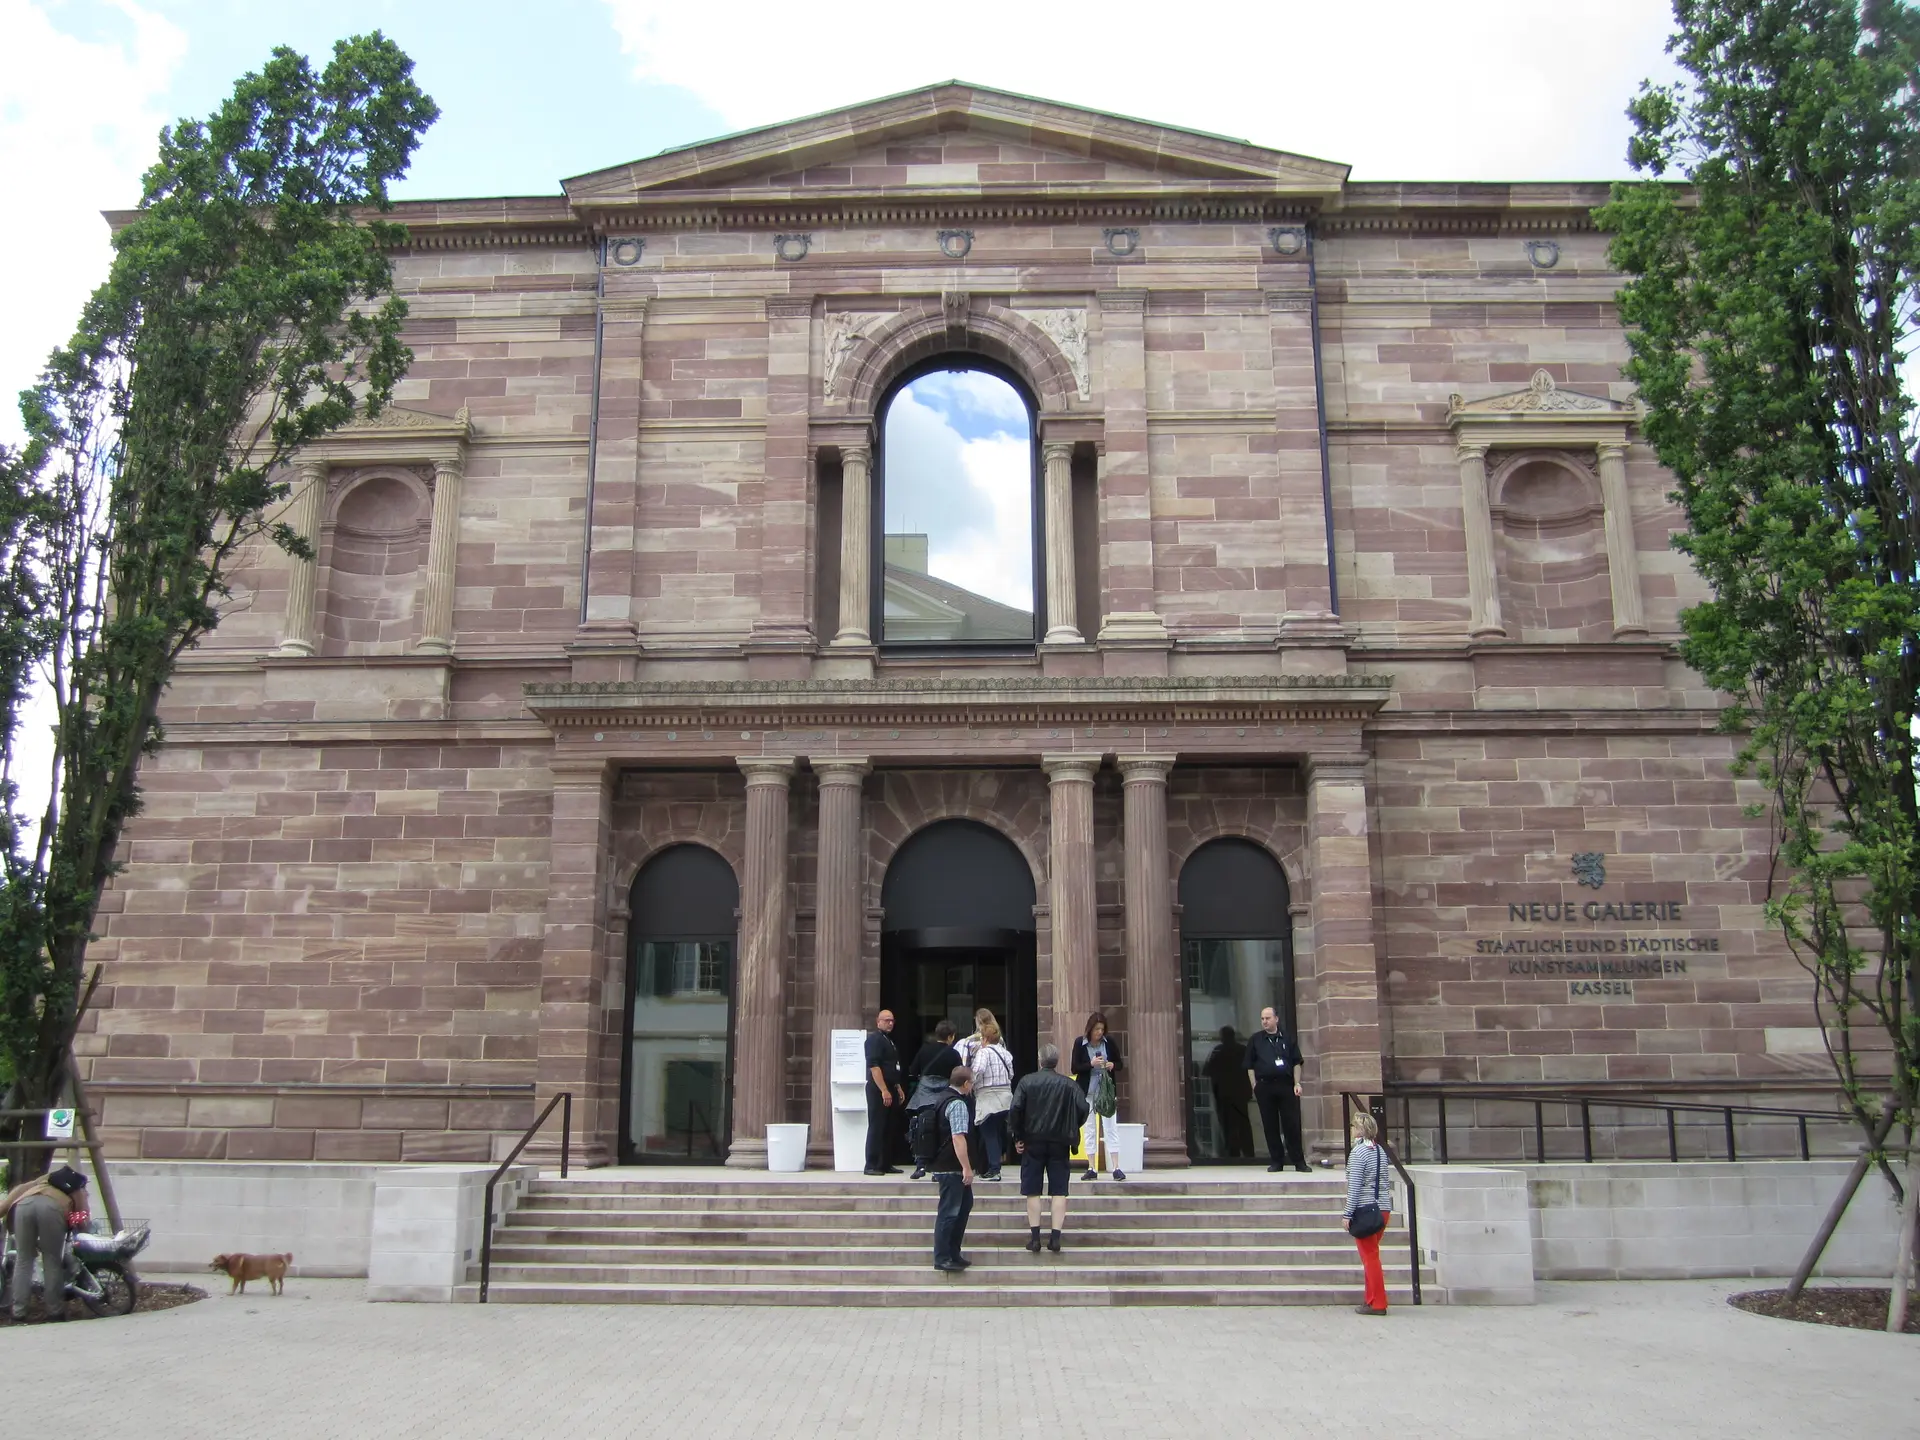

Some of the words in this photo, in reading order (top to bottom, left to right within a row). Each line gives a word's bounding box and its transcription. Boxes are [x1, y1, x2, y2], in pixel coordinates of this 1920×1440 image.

[1508, 902, 1577, 922] NEUE
[1582, 901, 1682, 921] GALERIE
[1476, 939, 1573, 953] STAATLICHE
[1577, 939, 1616, 953] UND
[1620, 936, 1719, 953] STÄDTISCHE
[1508, 959, 1687, 974] KUNSTSAMMLUNGEN
[1570, 981, 1632, 995] KASSEL
